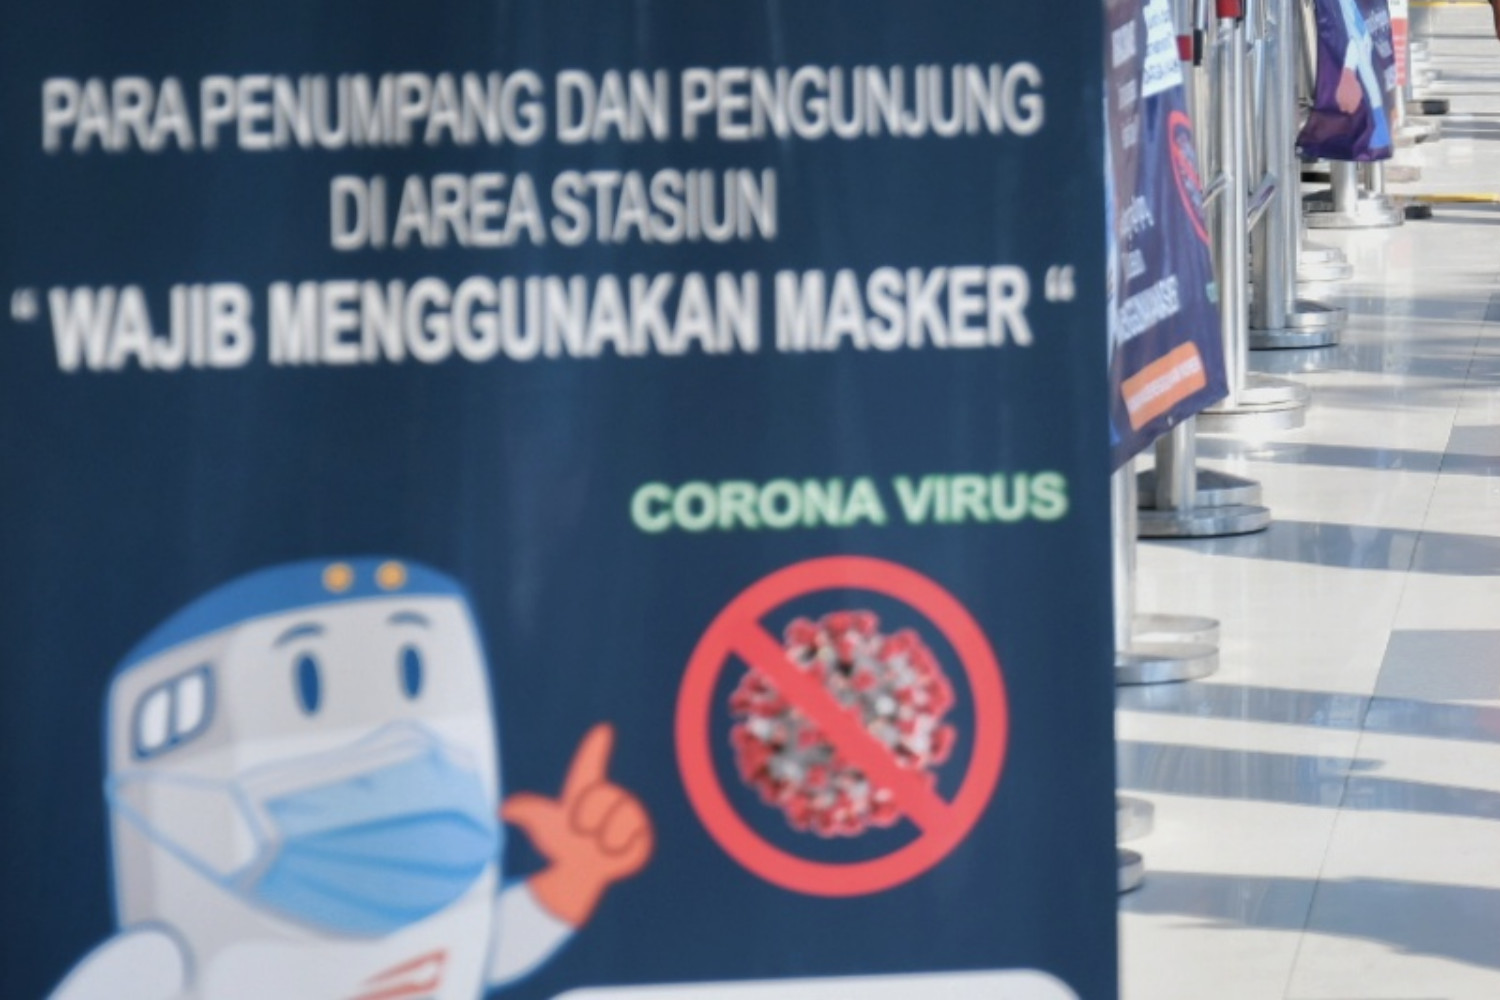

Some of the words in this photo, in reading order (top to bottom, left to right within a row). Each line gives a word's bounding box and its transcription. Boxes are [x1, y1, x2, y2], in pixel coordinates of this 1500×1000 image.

[41, 75, 193, 152] PARA
[199, 68, 546, 150] PENUMPANG
[555, 68, 669, 144] DAN
[680, 60, 1044, 141] PENGUNJUNG
[329, 174, 385, 250] DI
[392, 171, 547, 248] AREA
[549, 167, 777, 246] STASIUN
[47, 281, 255, 372] WAJIB
[266, 273, 761, 366] MENGGUNAKAN
[773, 263, 1033, 353] MASKER
[628, 474, 889, 534] CORONA
[891, 469, 1069, 525] VIRUS
